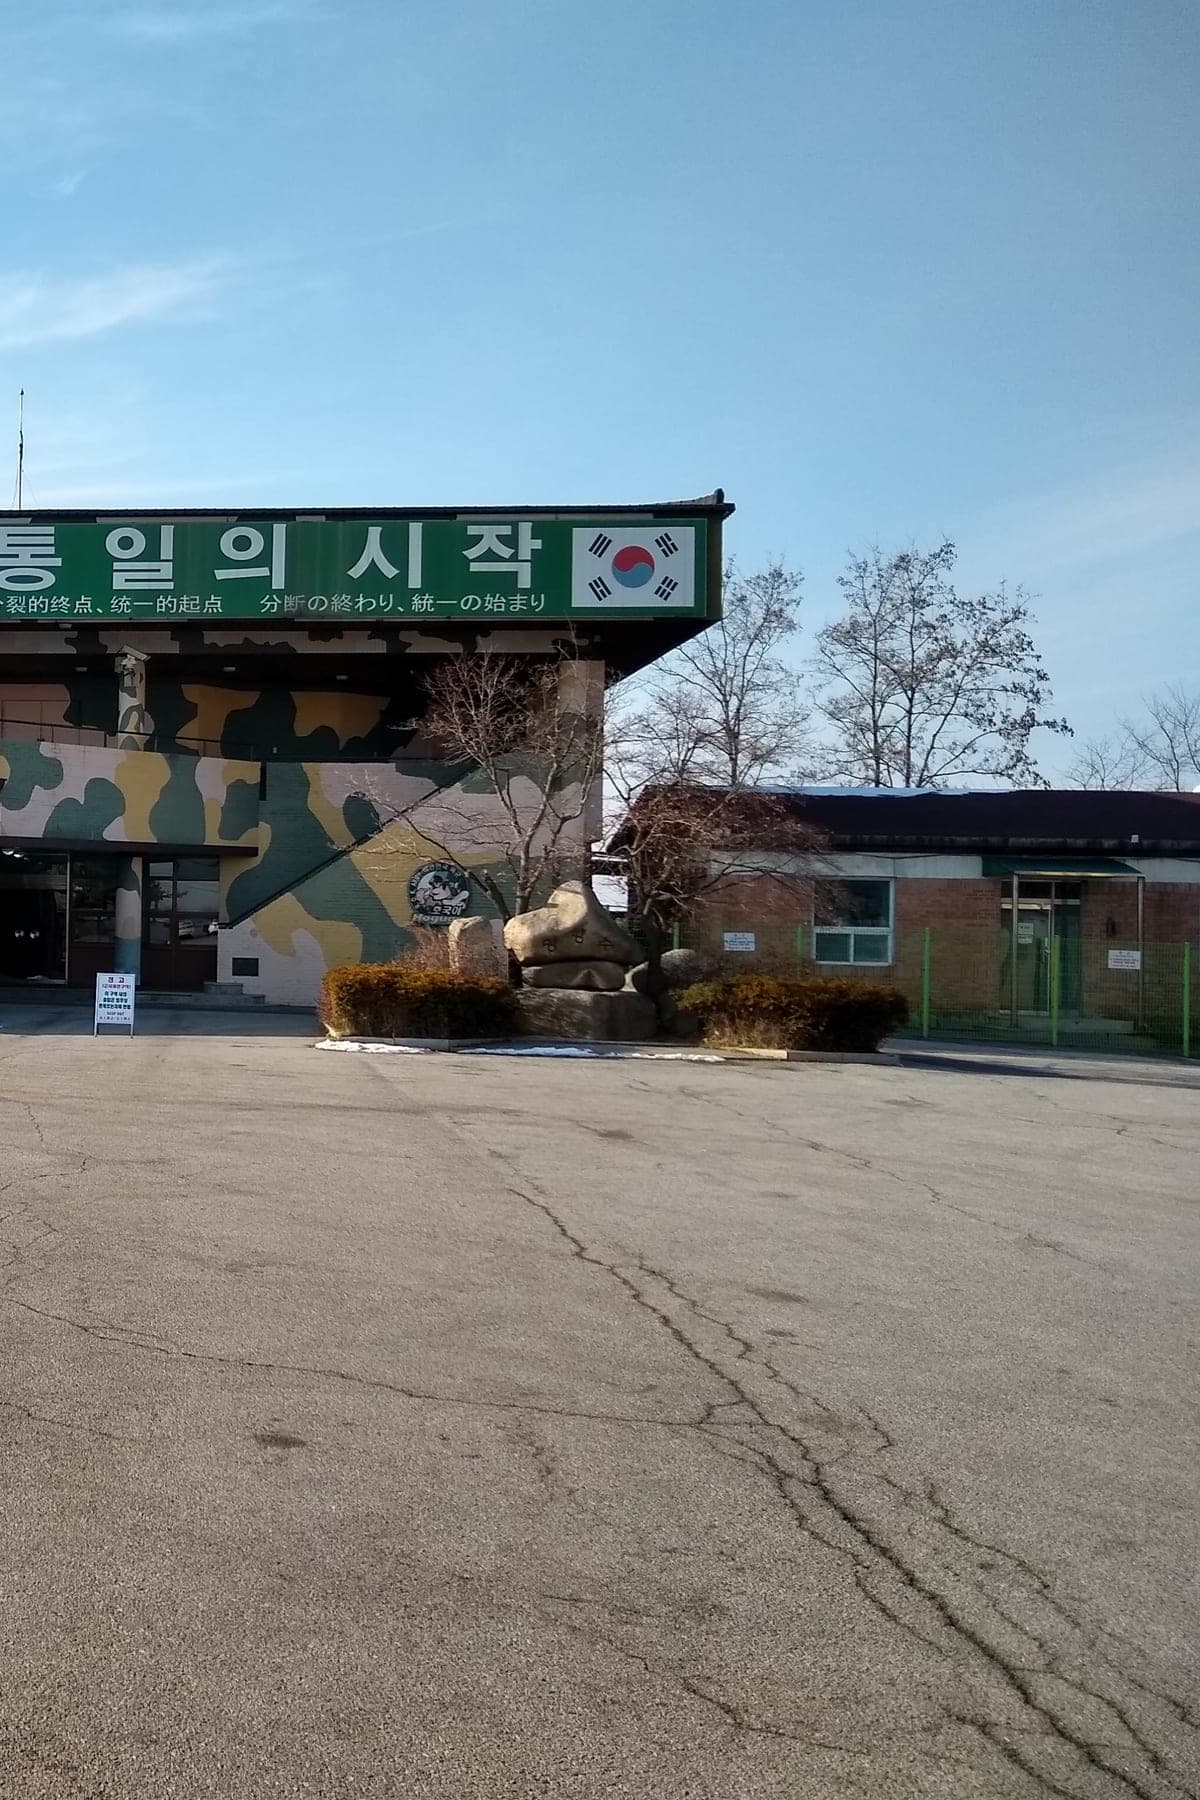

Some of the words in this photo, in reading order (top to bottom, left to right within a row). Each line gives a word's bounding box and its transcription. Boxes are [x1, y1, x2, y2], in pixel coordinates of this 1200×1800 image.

[347, 522, 543, 589] 시작
[260, 593, 545, 614] 分断の終わり、統一の始まり
